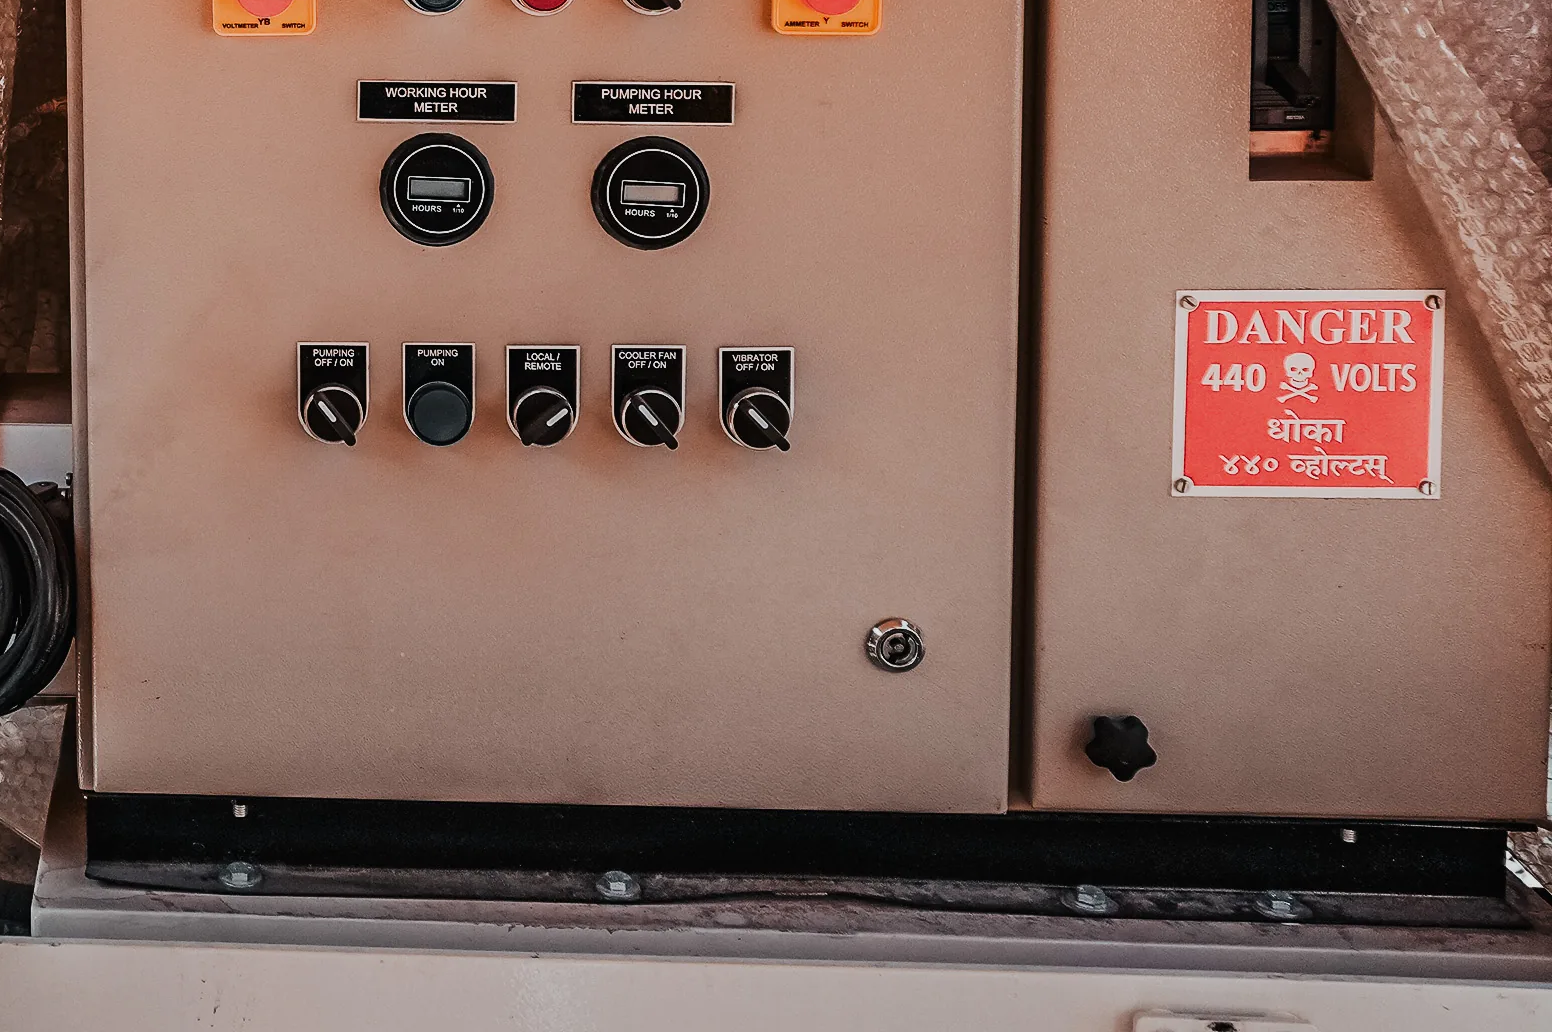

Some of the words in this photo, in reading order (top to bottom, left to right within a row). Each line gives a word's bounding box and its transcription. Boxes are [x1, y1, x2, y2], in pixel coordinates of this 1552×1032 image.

[258, 18, 270, 26] YB
[385, 88, 446, 97] WORKING
[450, 88, 487, 98] HOUR
[602, 89, 660, 99] PUMPING
[664, 89, 701, 99] HOUR
[414, 102, 458, 112] METER
[629, 104, 673, 114] METER
[625, 209, 655, 217] HOURS
[1203, 309, 1415, 344] DANGER
[313, 349, 354, 357] PUMPING
[418, 349, 458, 357] PUMPING
[527, 353, 555, 361] LOCAL
[315, 358, 332, 366] OFF
[431, 358, 444, 366] ON
[732, 354, 778, 362] VIBRATOR
[525, 362, 561, 370] REMOTE
[736, 363, 753, 371] OFF
[761, 363, 774, 371] ON
[1201, 363, 1266, 392] 440
[1331, 363, 1417, 392] VOLTS
[1267, 409, 1346, 443] धोका
[1219, 454, 1279, 475] ४४०
